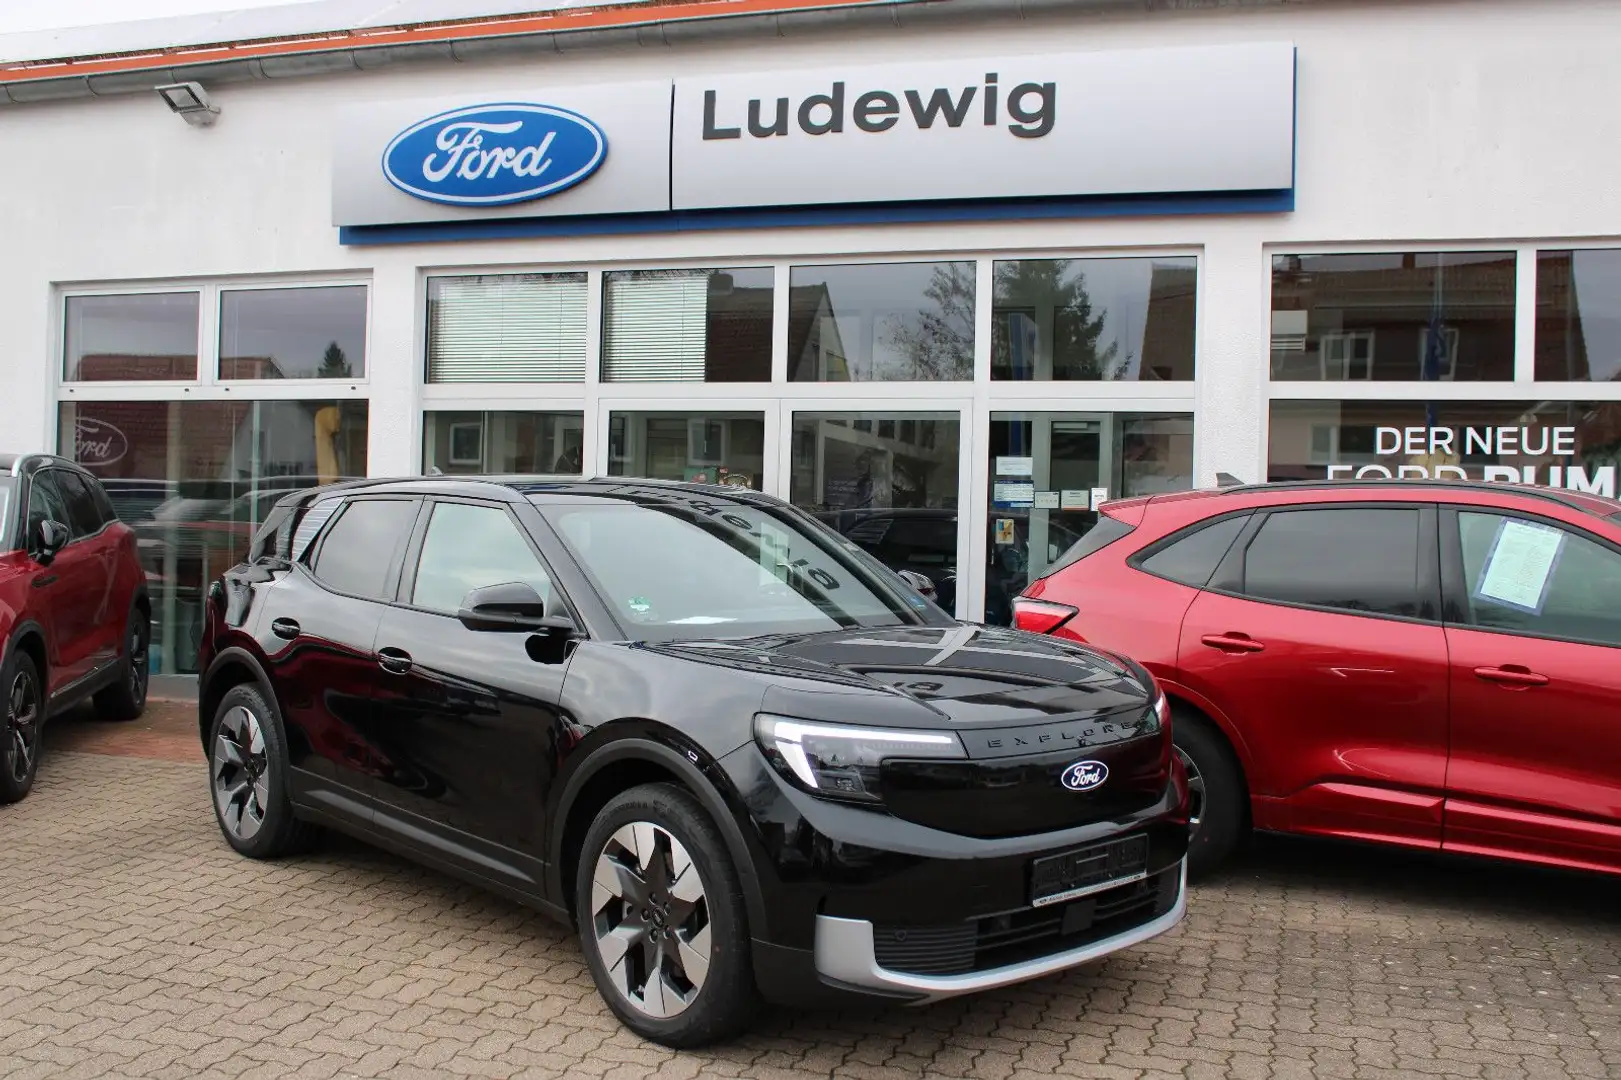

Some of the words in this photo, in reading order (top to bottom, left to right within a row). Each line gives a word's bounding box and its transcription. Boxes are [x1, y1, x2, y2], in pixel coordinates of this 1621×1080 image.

[701, 72, 1057, 138] Ludewig
[421, 120, 557, 182] Ford
[1375, 426, 1454, 455] DER
[1465, 426, 1576, 455] NEUE
[1071, 765, 1100, 787] Ford
